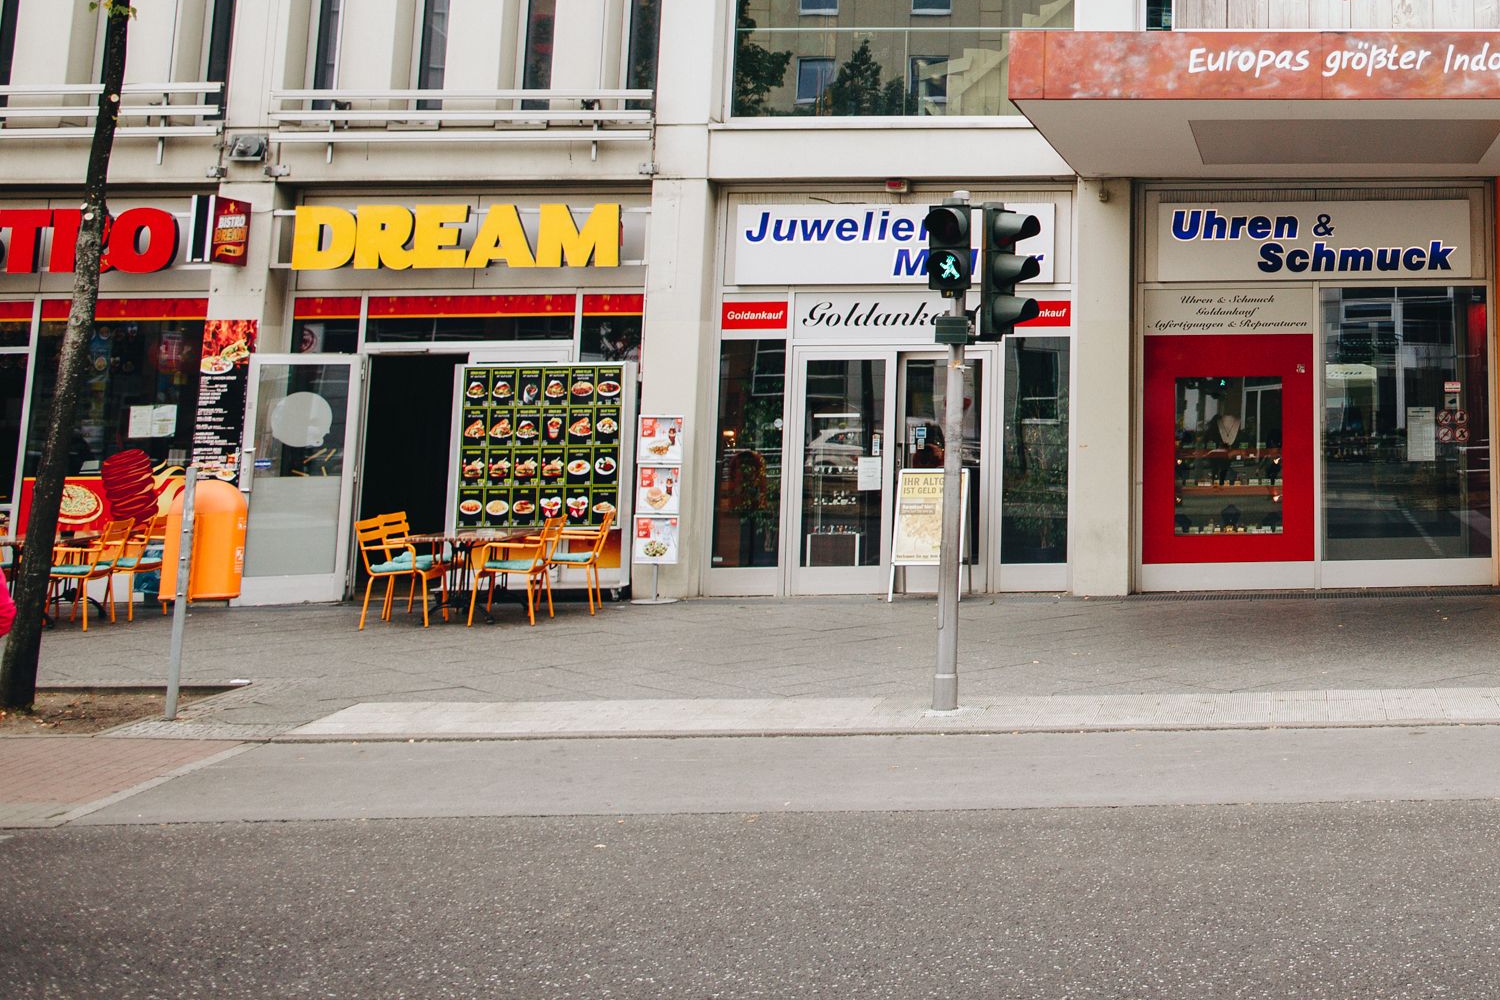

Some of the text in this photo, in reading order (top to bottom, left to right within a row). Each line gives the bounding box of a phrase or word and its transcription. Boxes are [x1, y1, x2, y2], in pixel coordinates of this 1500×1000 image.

[1188, 46, 1310, 78] Europas
[1322, 42, 1431, 78] größter
[1171, 208, 1335, 242] Uhren &
[291, 202, 621, 271] DREAM
[1257, 240, 1457, 273] Schmuck
[1180, 295, 1213, 304] Uhren
[1228, 294, 1275, 304] Schmuck
[727, 310, 784, 321] Goldankauf
[802, 301, 942, 327] Goldank
[1038, 308, 1067, 318] nkauf
[1195, 306, 1260, 318] Goldankauf
[904, 477, 920, 486] IHR
[917, 486, 937, 494] GELD
